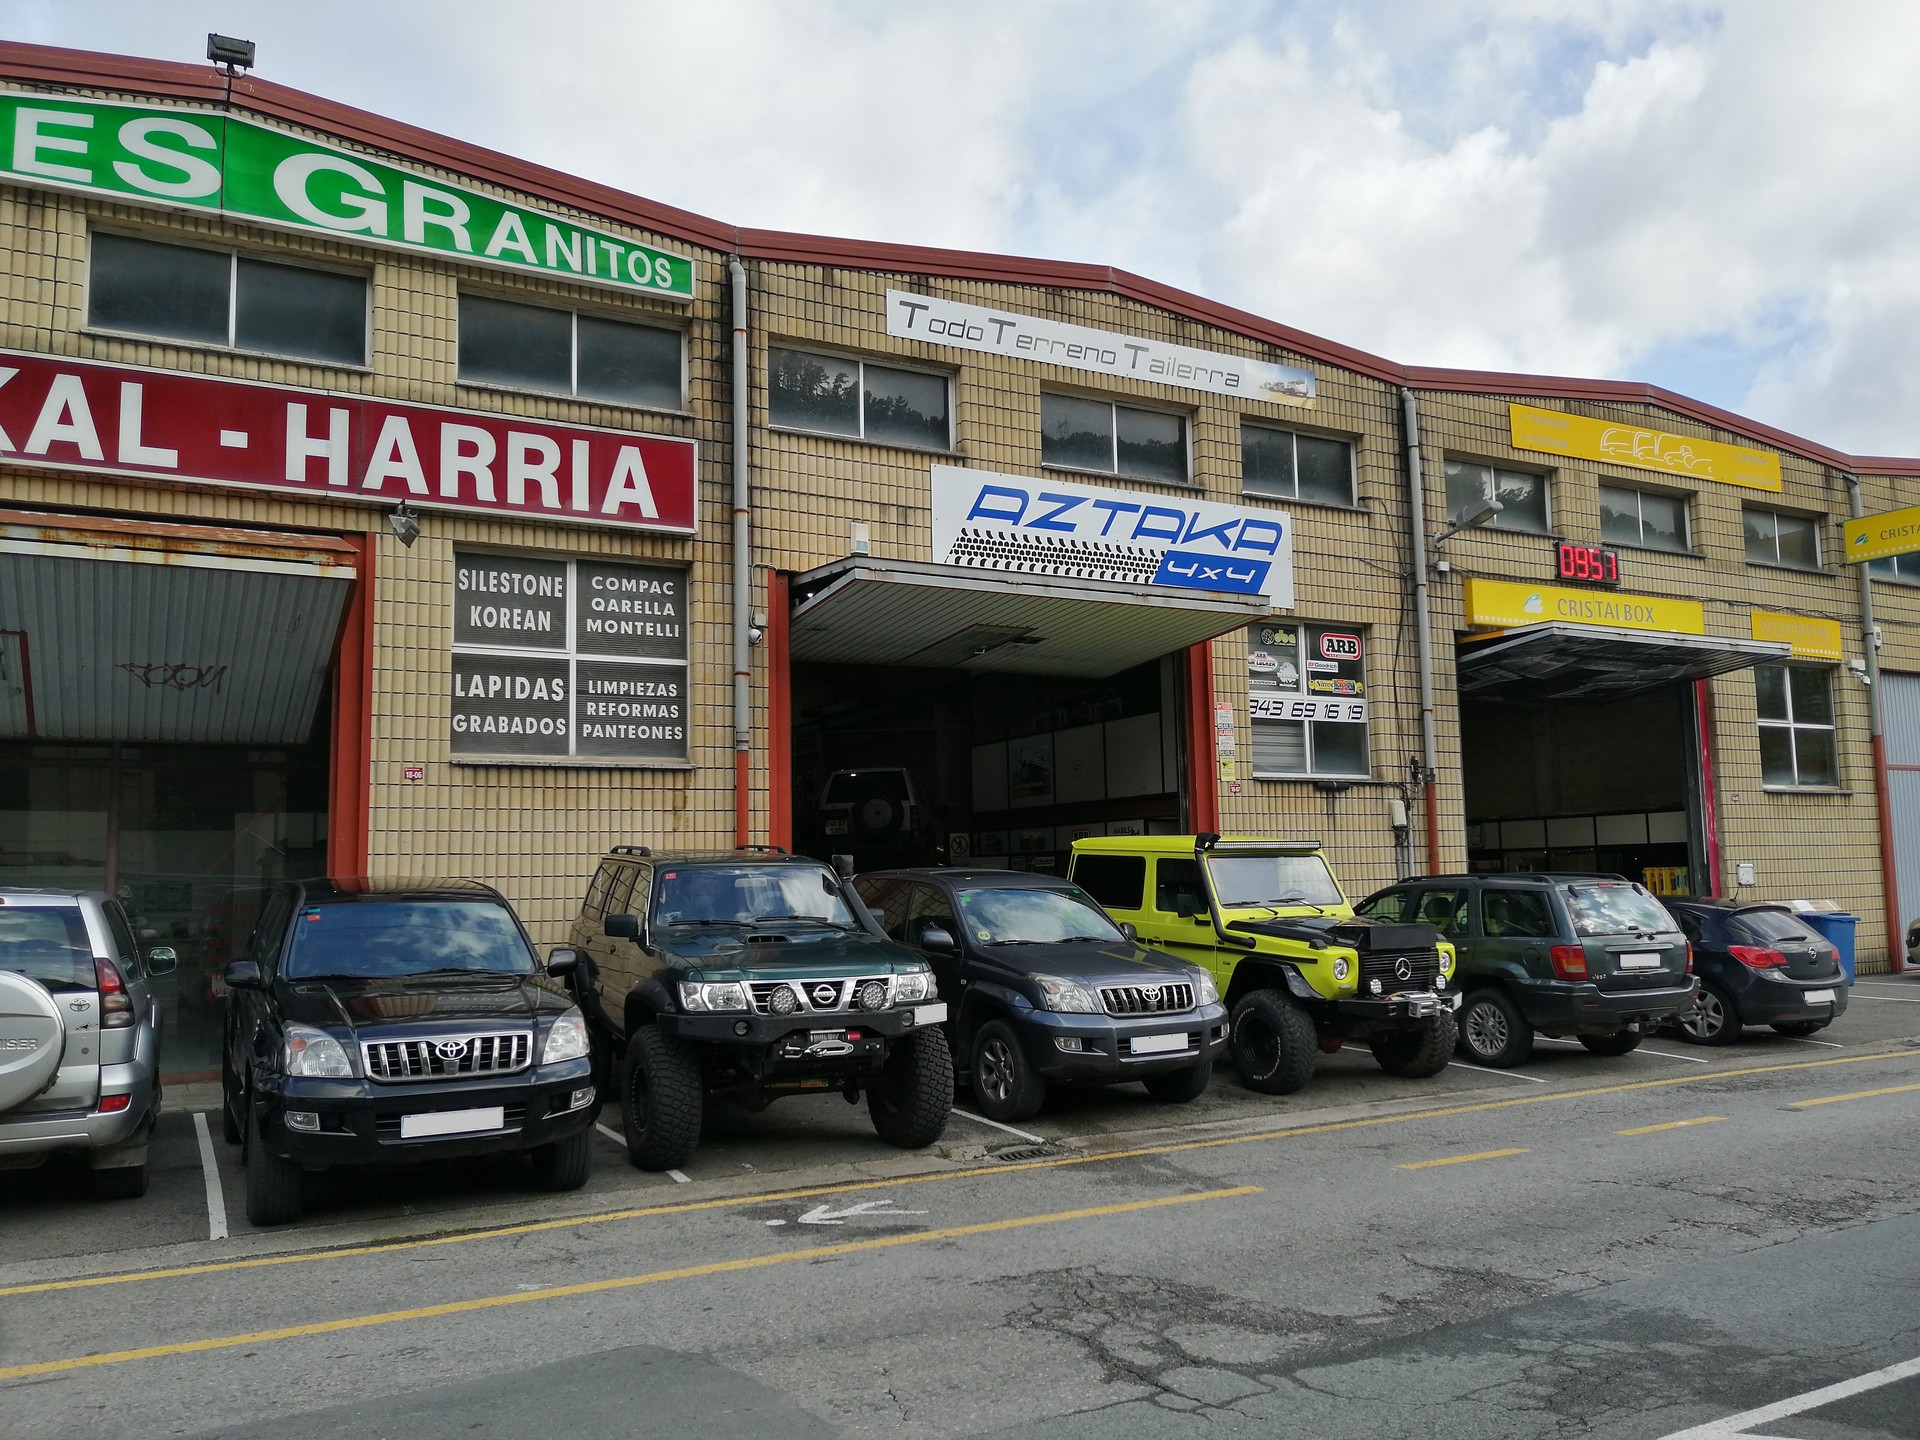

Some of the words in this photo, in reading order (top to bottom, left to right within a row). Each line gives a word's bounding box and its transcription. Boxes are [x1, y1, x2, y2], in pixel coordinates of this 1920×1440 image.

[12, 107, 222, 199] ES
[272, 153, 673, 288] GRANITOS
[286, 402, 660, 518] HARRIA
[966, 484, 1283, 556] AZTAKA
[1166, 559, 1257, 584] 4x4
[458, 568, 563, 598] SILESTONE
[591, 576, 674, 595] COMPAC
[591, 597, 675, 616] QARELLA
[1557, 598, 1655, 624] CRISTALBOX
[470, 605, 551, 632] KOREAN
[586, 618, 680, 637] MONTELLI
[1325, 638, 1357, 654] ARB
[455, 673, 564, 702] LAPIDAS
[588, 680, 678, 697] LIMPIEZAS
[586, 702, 679, 719] REFORMAS
[1291, 702, 1317, 718] 69
[1323, 703, 1340, 719] 16
[1347, 705, 1364, 720] 19
[452, 714, 566, 736] GRABADOS
[582, 723, 683, 740] PANTEONES
[0, 1037, 38, 1050] ISER
